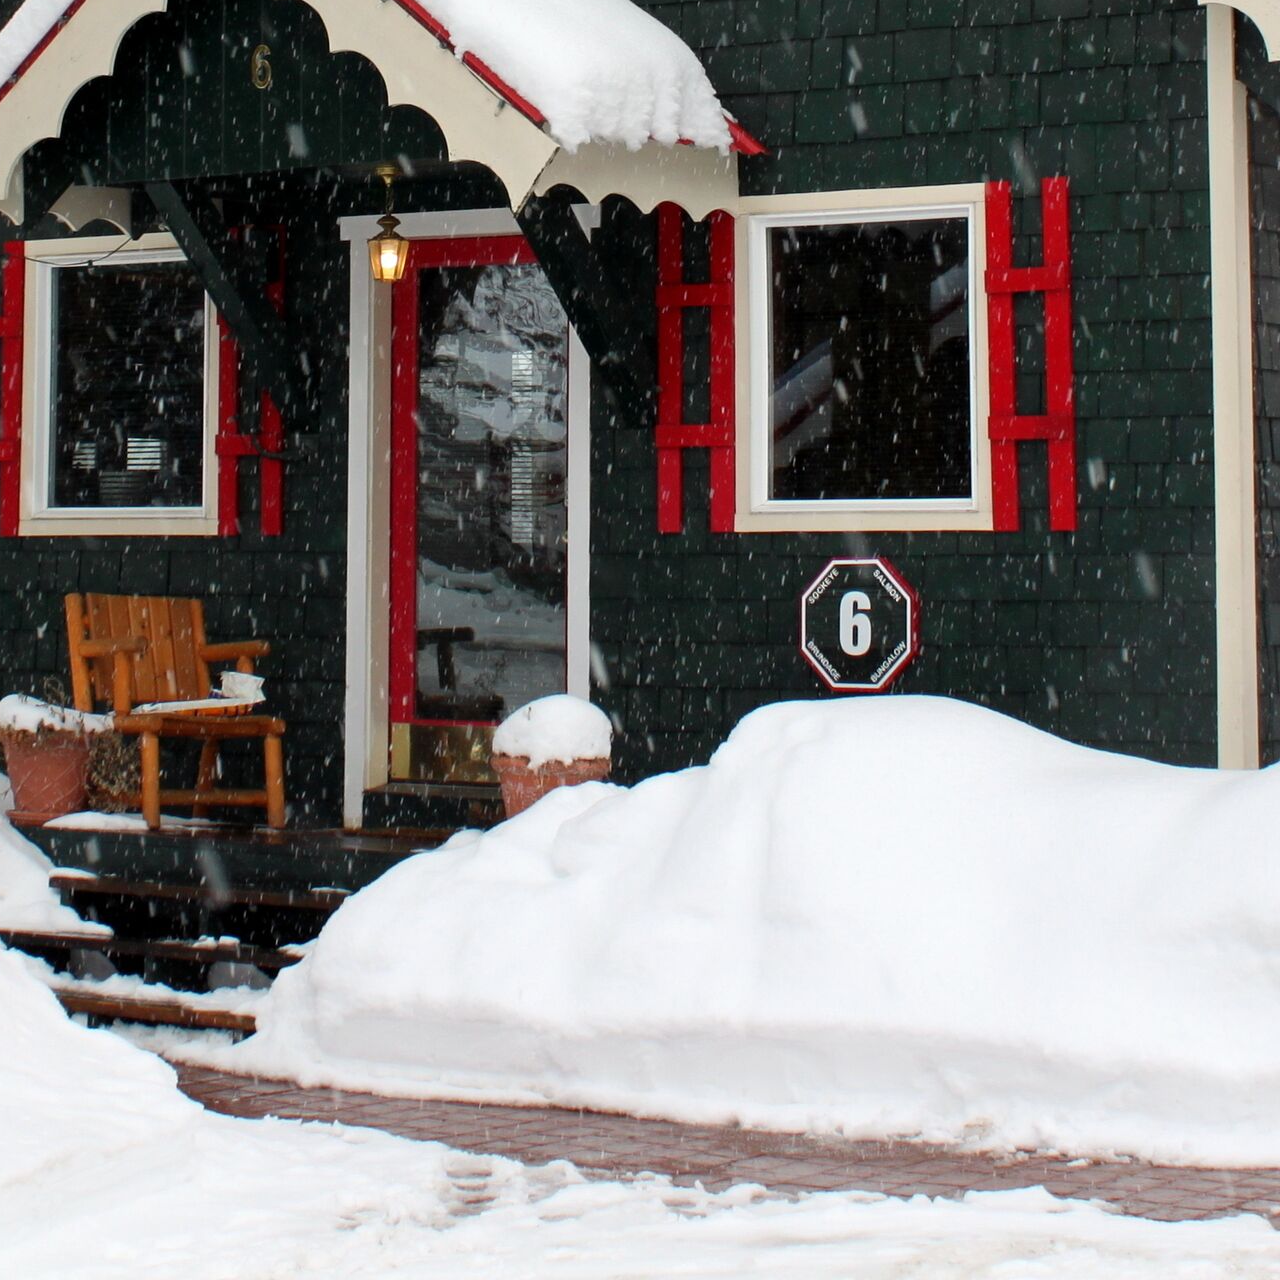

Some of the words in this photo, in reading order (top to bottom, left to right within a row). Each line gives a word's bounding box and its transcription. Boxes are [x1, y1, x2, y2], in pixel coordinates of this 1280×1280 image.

[251, 44, 271, 89] 6
[808, 568, 840, 605] SOCKEYE
[872, 569, 902, 603] SALMON
[839, 591, 872, 656] 6
[806, 641, 842, 681] BRUNDAGE
[870, 641, 907, 683] BUNGALOW
